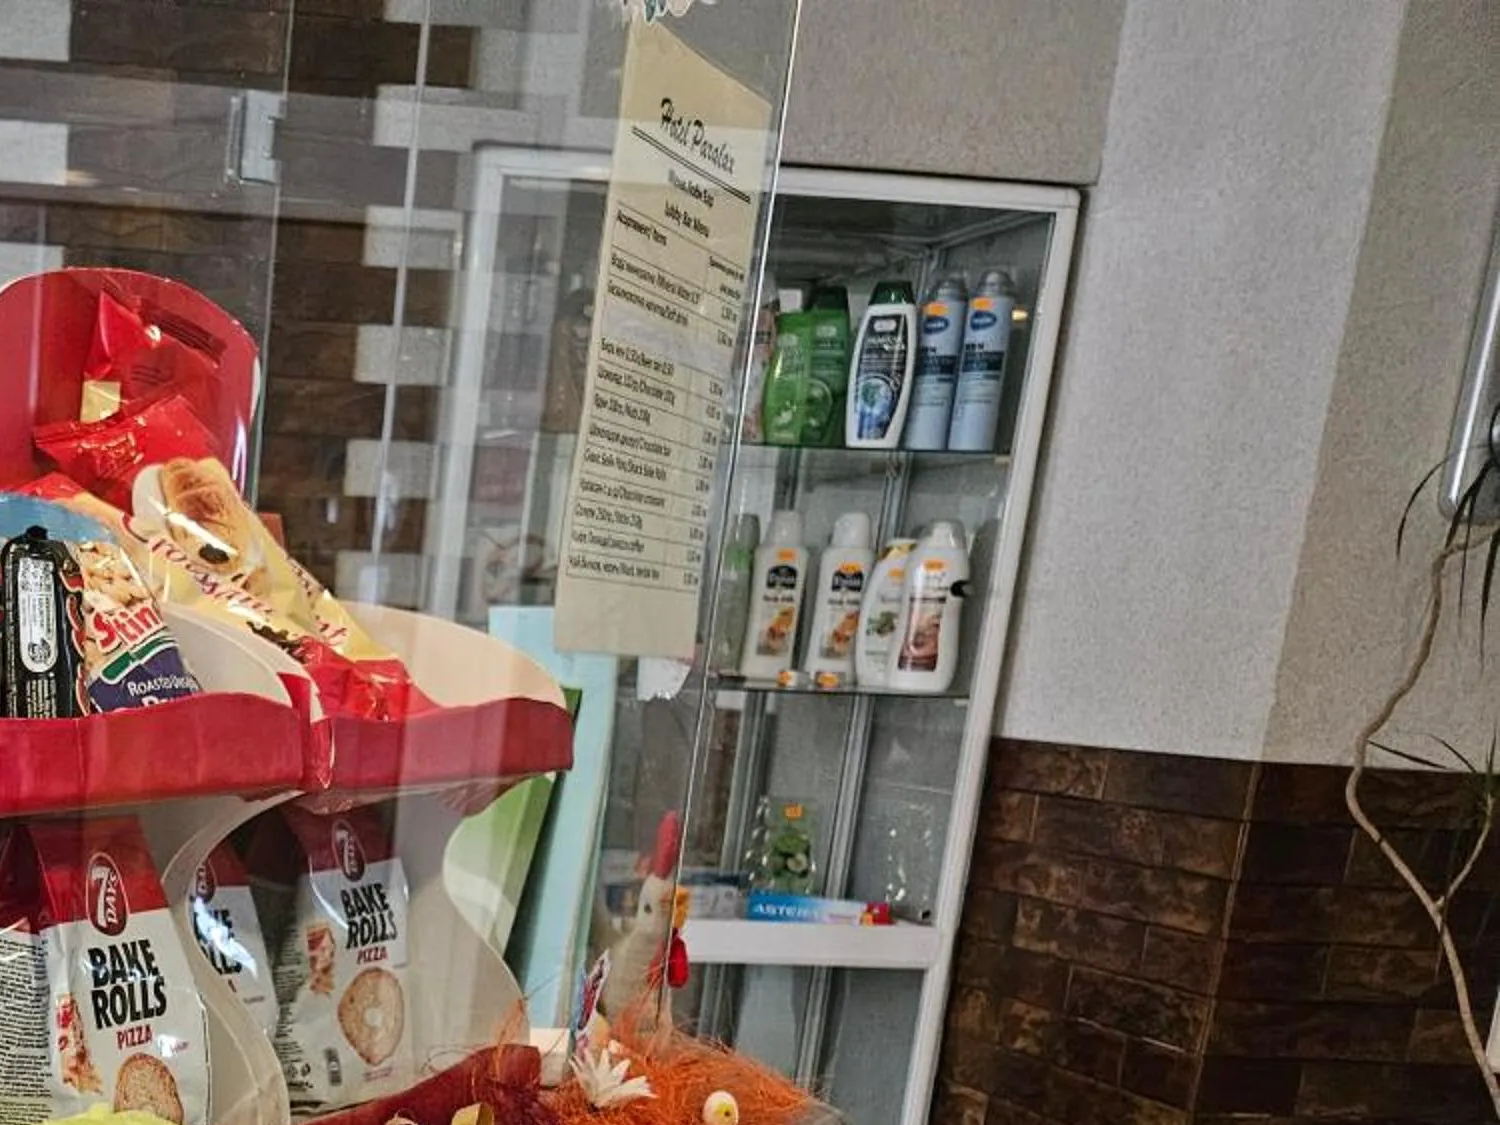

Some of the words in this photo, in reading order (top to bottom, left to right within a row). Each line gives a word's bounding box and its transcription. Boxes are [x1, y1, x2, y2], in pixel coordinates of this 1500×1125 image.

[340, 882, 391, 917] BAKE
[345, 910, 398, 950] ROLLS
[88, 938, 161, 988] BAKE
[356, 945, 389, 965] PIZZA
[91, 975, 168, 1030] ROLLS
[116, 1023, 154, 1050] PIZZA
